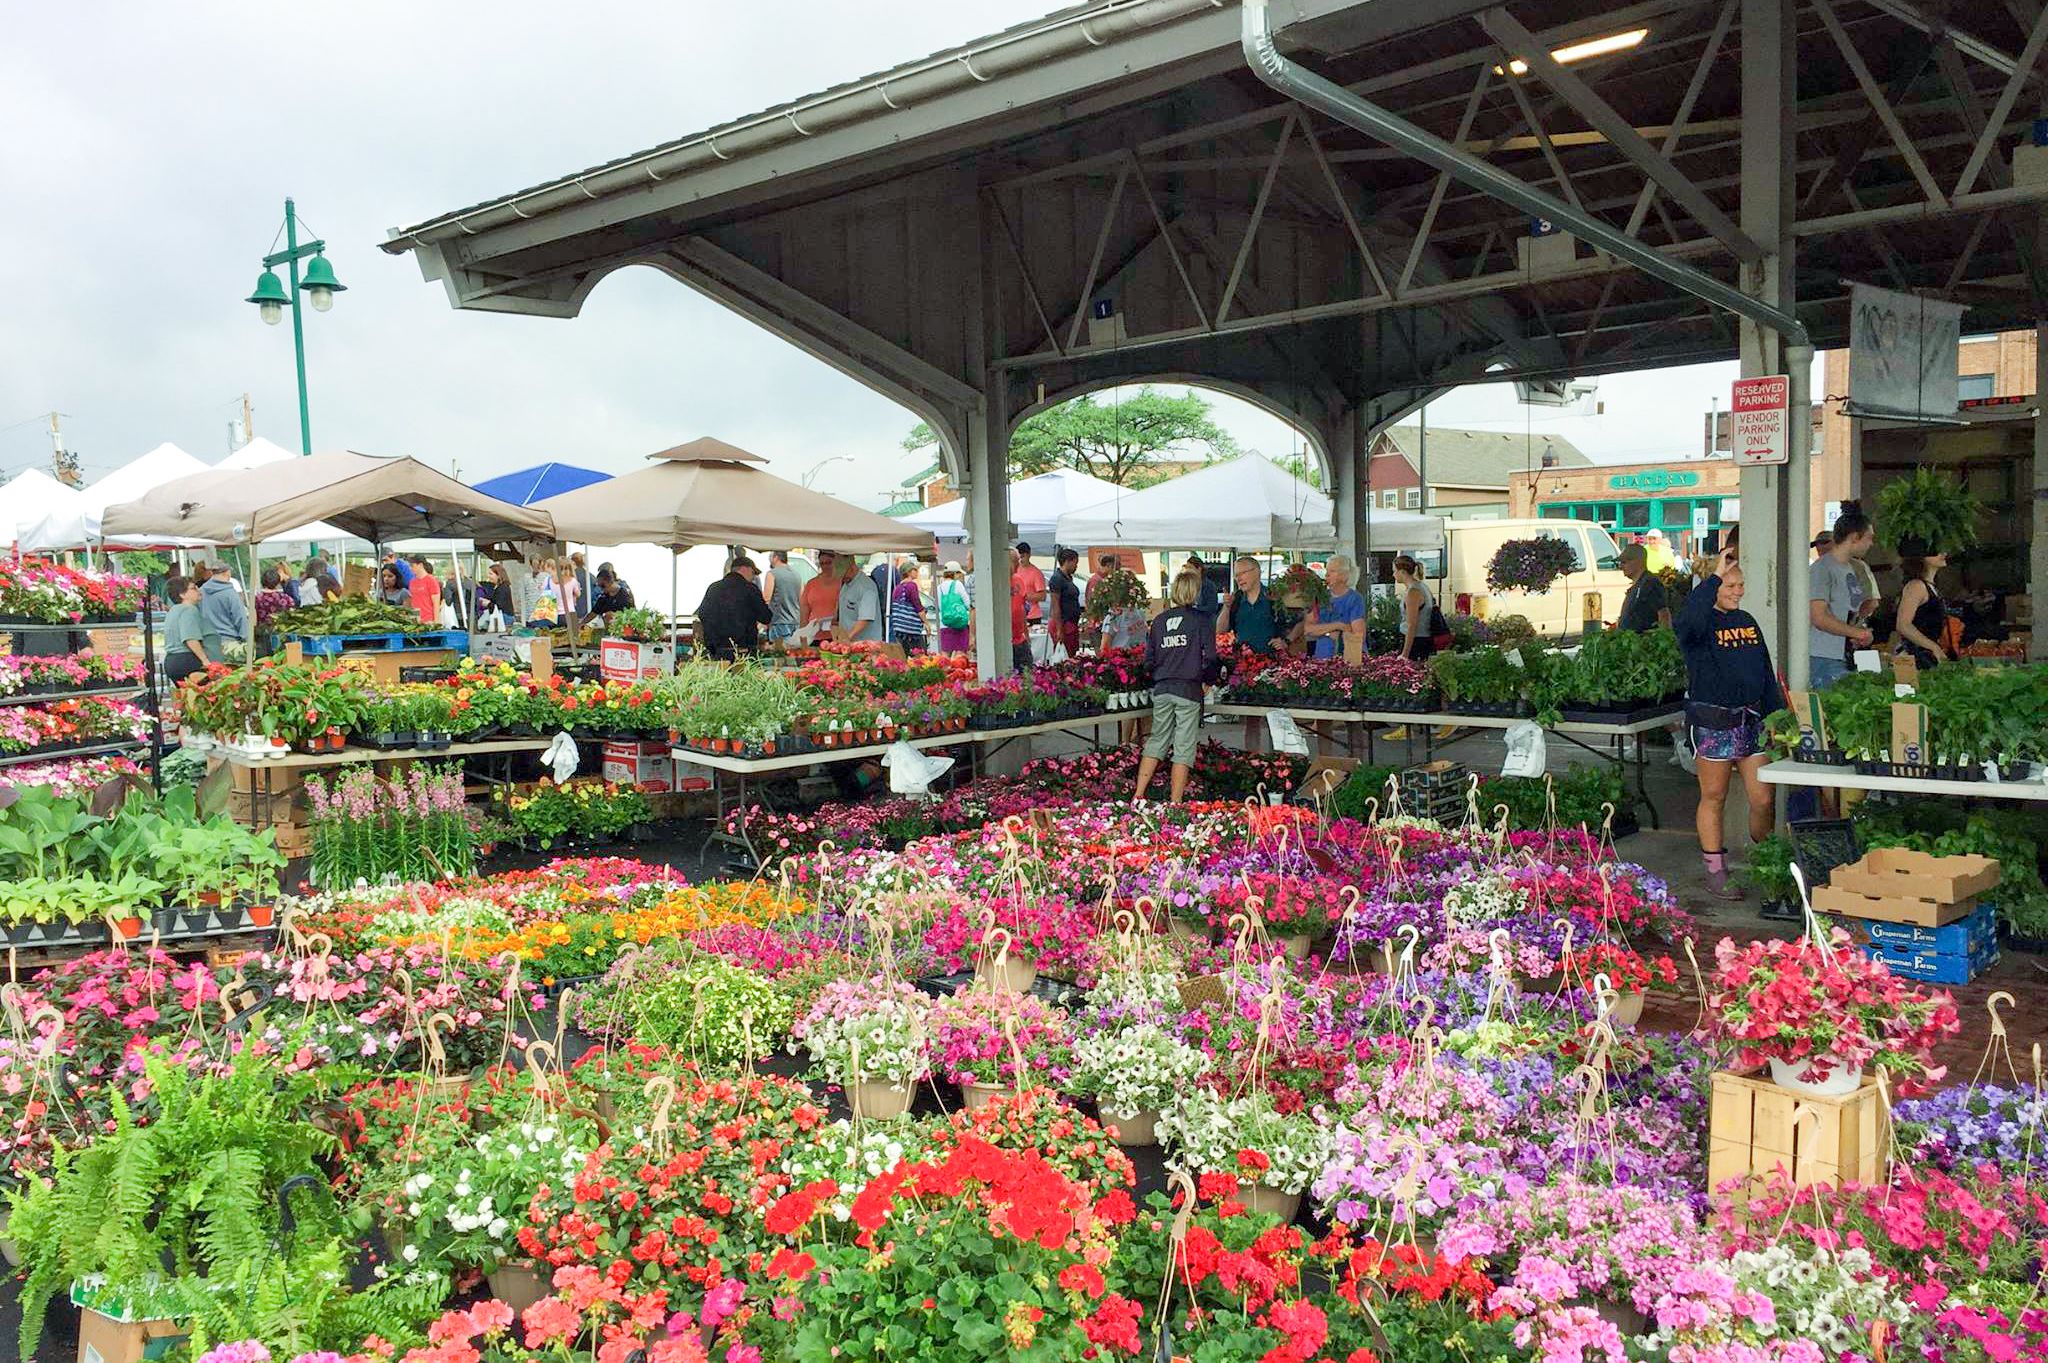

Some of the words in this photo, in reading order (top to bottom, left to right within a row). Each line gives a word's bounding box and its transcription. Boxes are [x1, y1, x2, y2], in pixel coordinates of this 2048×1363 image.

[1735, 383, 1784, 396] RESERVED
[1740, 394, 1780, 407] PARKING
[1740, 411, 1780, 424] VENDOR
[1738, 423, 1780, 435] PARKING
[1746, 434, 1771, 446] ONLY
[1619, 473, 1687, 487] BAKERY
[1160, 634, 1187, 648] JONES
[1913, 928, 1937, 942] Farms
[1914, 956, 1938, 971] Farms
